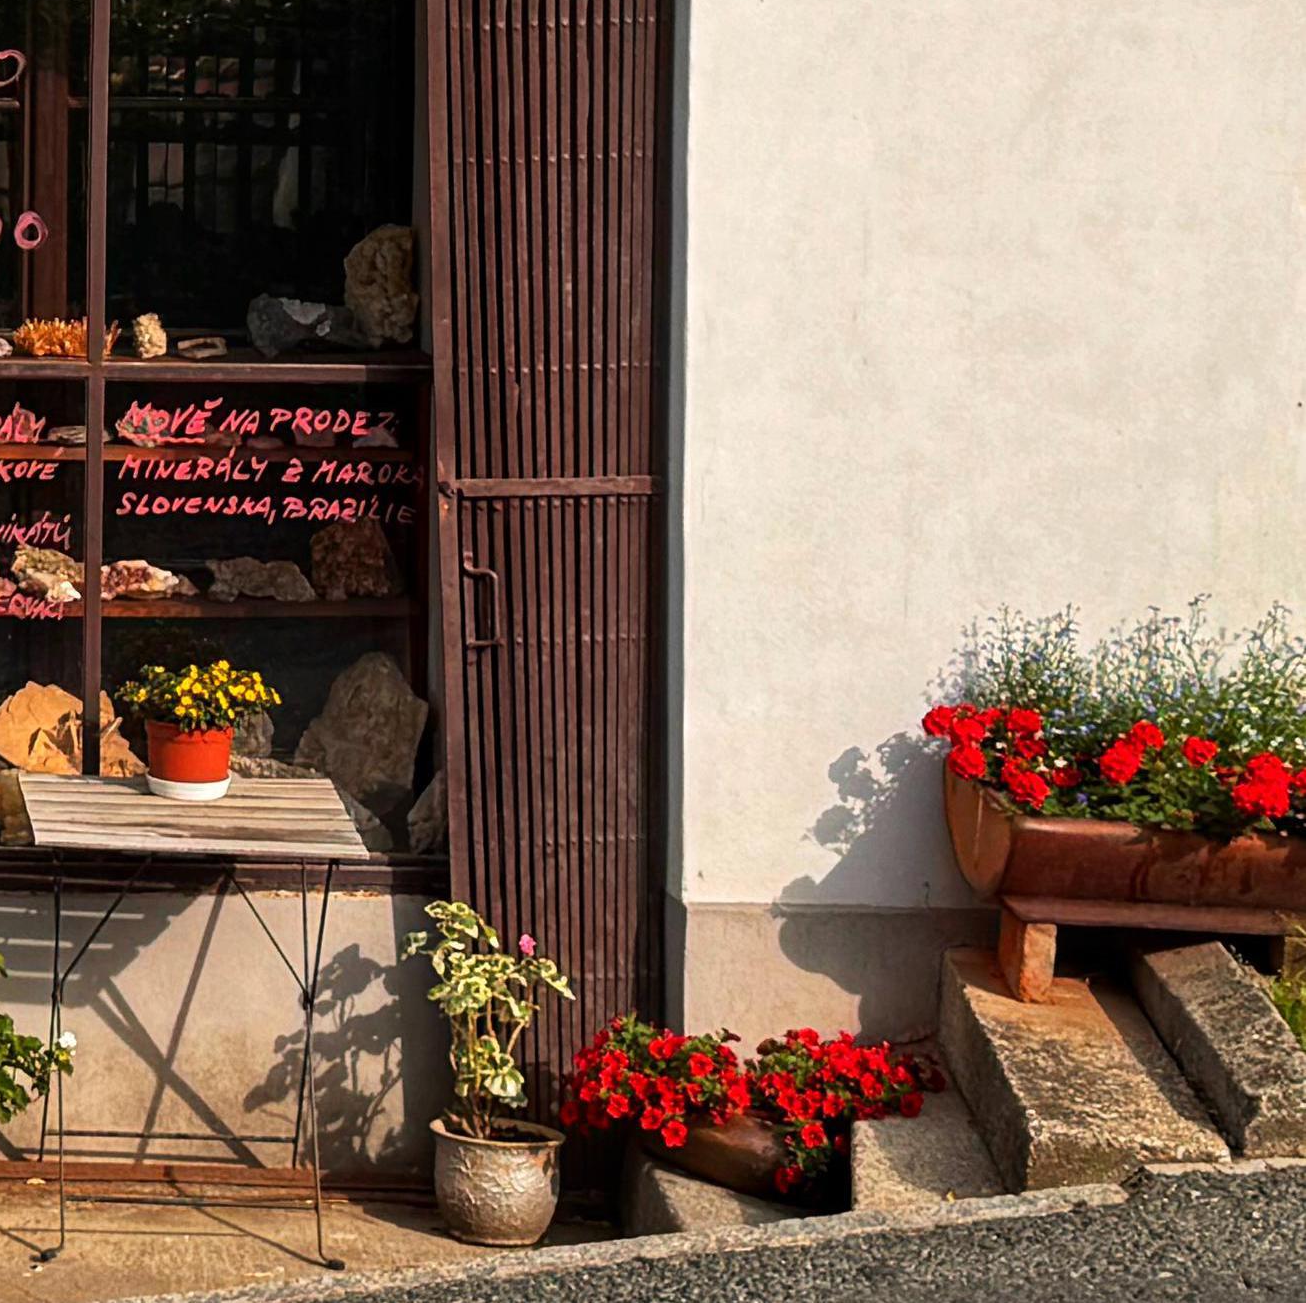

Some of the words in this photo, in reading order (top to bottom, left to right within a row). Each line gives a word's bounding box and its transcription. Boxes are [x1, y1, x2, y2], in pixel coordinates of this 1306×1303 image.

[126, 397, 223, 435] NOVĚ
[219, 408, 260, 435] NA
[118, 446, 268, 483] MINERÁLY
